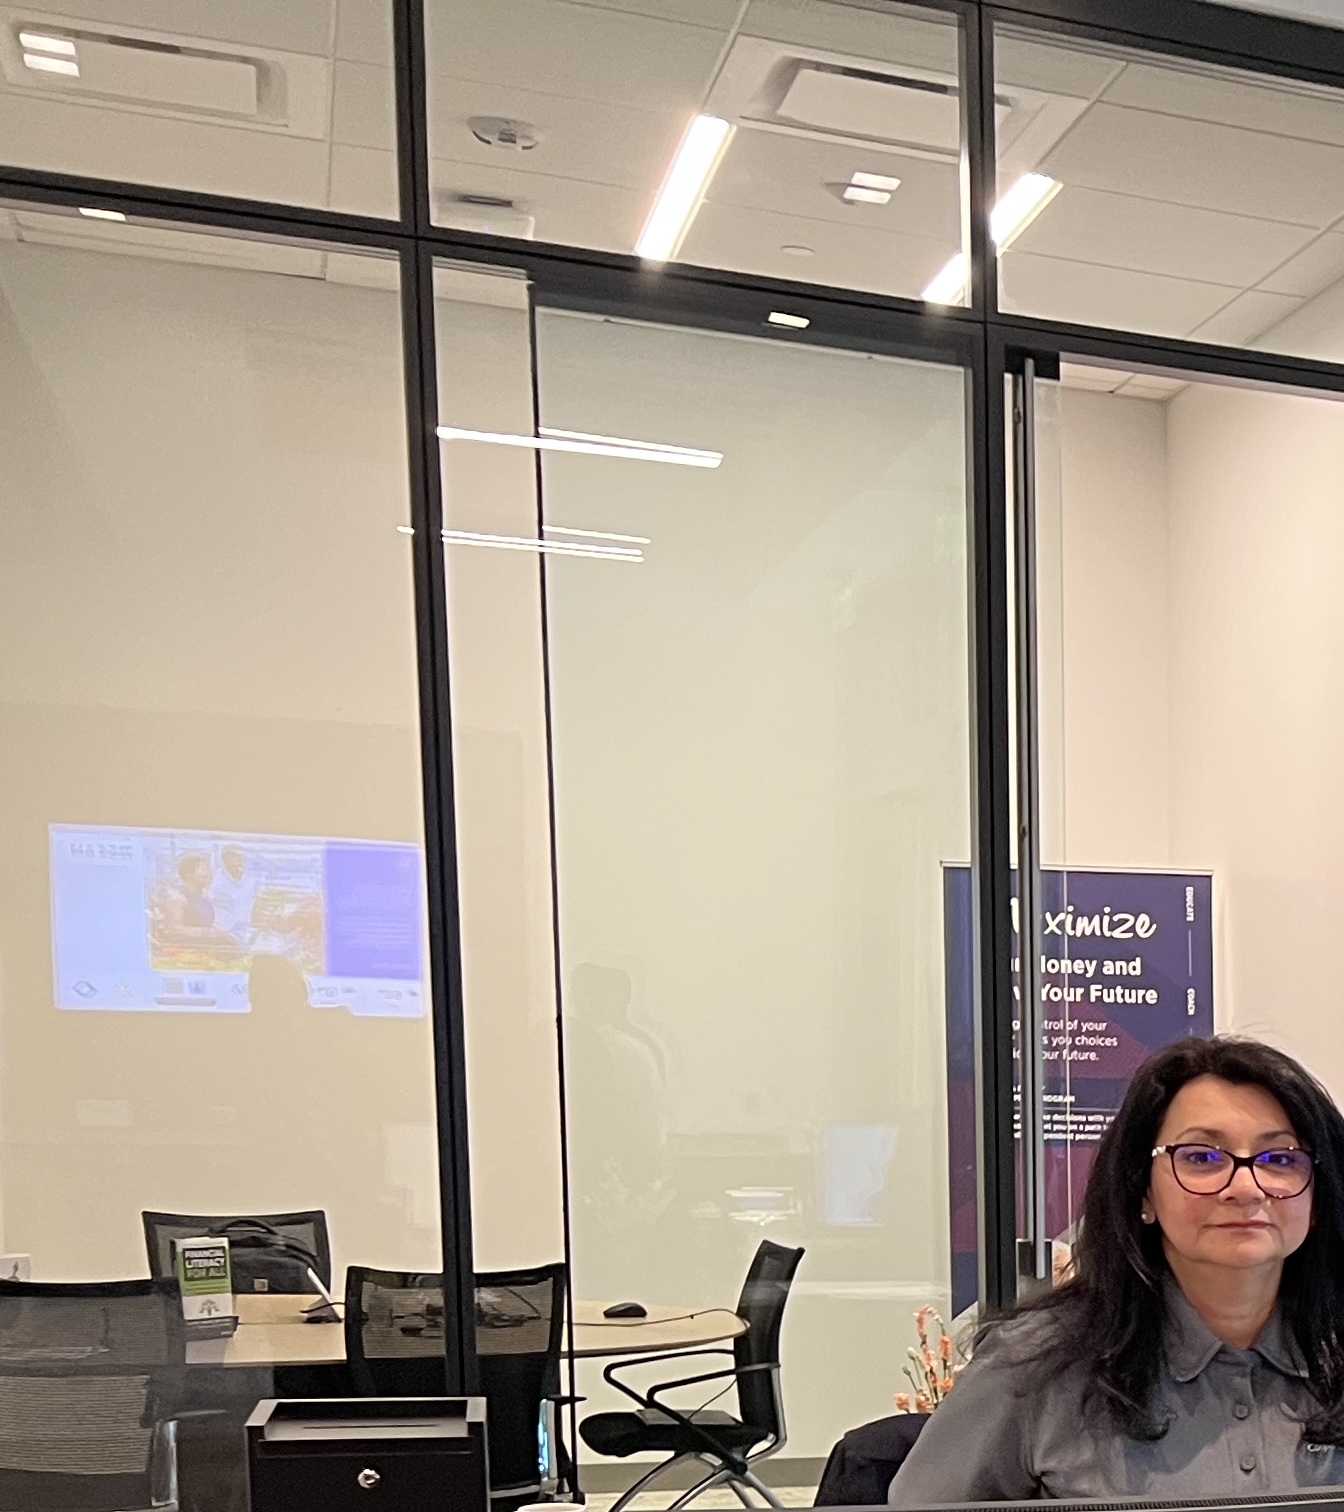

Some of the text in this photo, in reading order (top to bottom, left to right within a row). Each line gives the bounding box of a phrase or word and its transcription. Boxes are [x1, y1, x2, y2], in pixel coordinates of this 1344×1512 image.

[1010, 897, 1157, 938] ximize
[1102, 957, 1141, 976] and
[1041, 983, 1158, 1004] Your Future
[1042, 1019, 1107, 1032] trol of your
[1051, 1036, 1072, 1047] you
[1075, 1035, 1118, 1046] choices
[1042, 1049, 1099, 1061] our future.
[185, 1257, 225, 1268] LITERACY
[187, 1267, 226, 1278] FOR ALL
